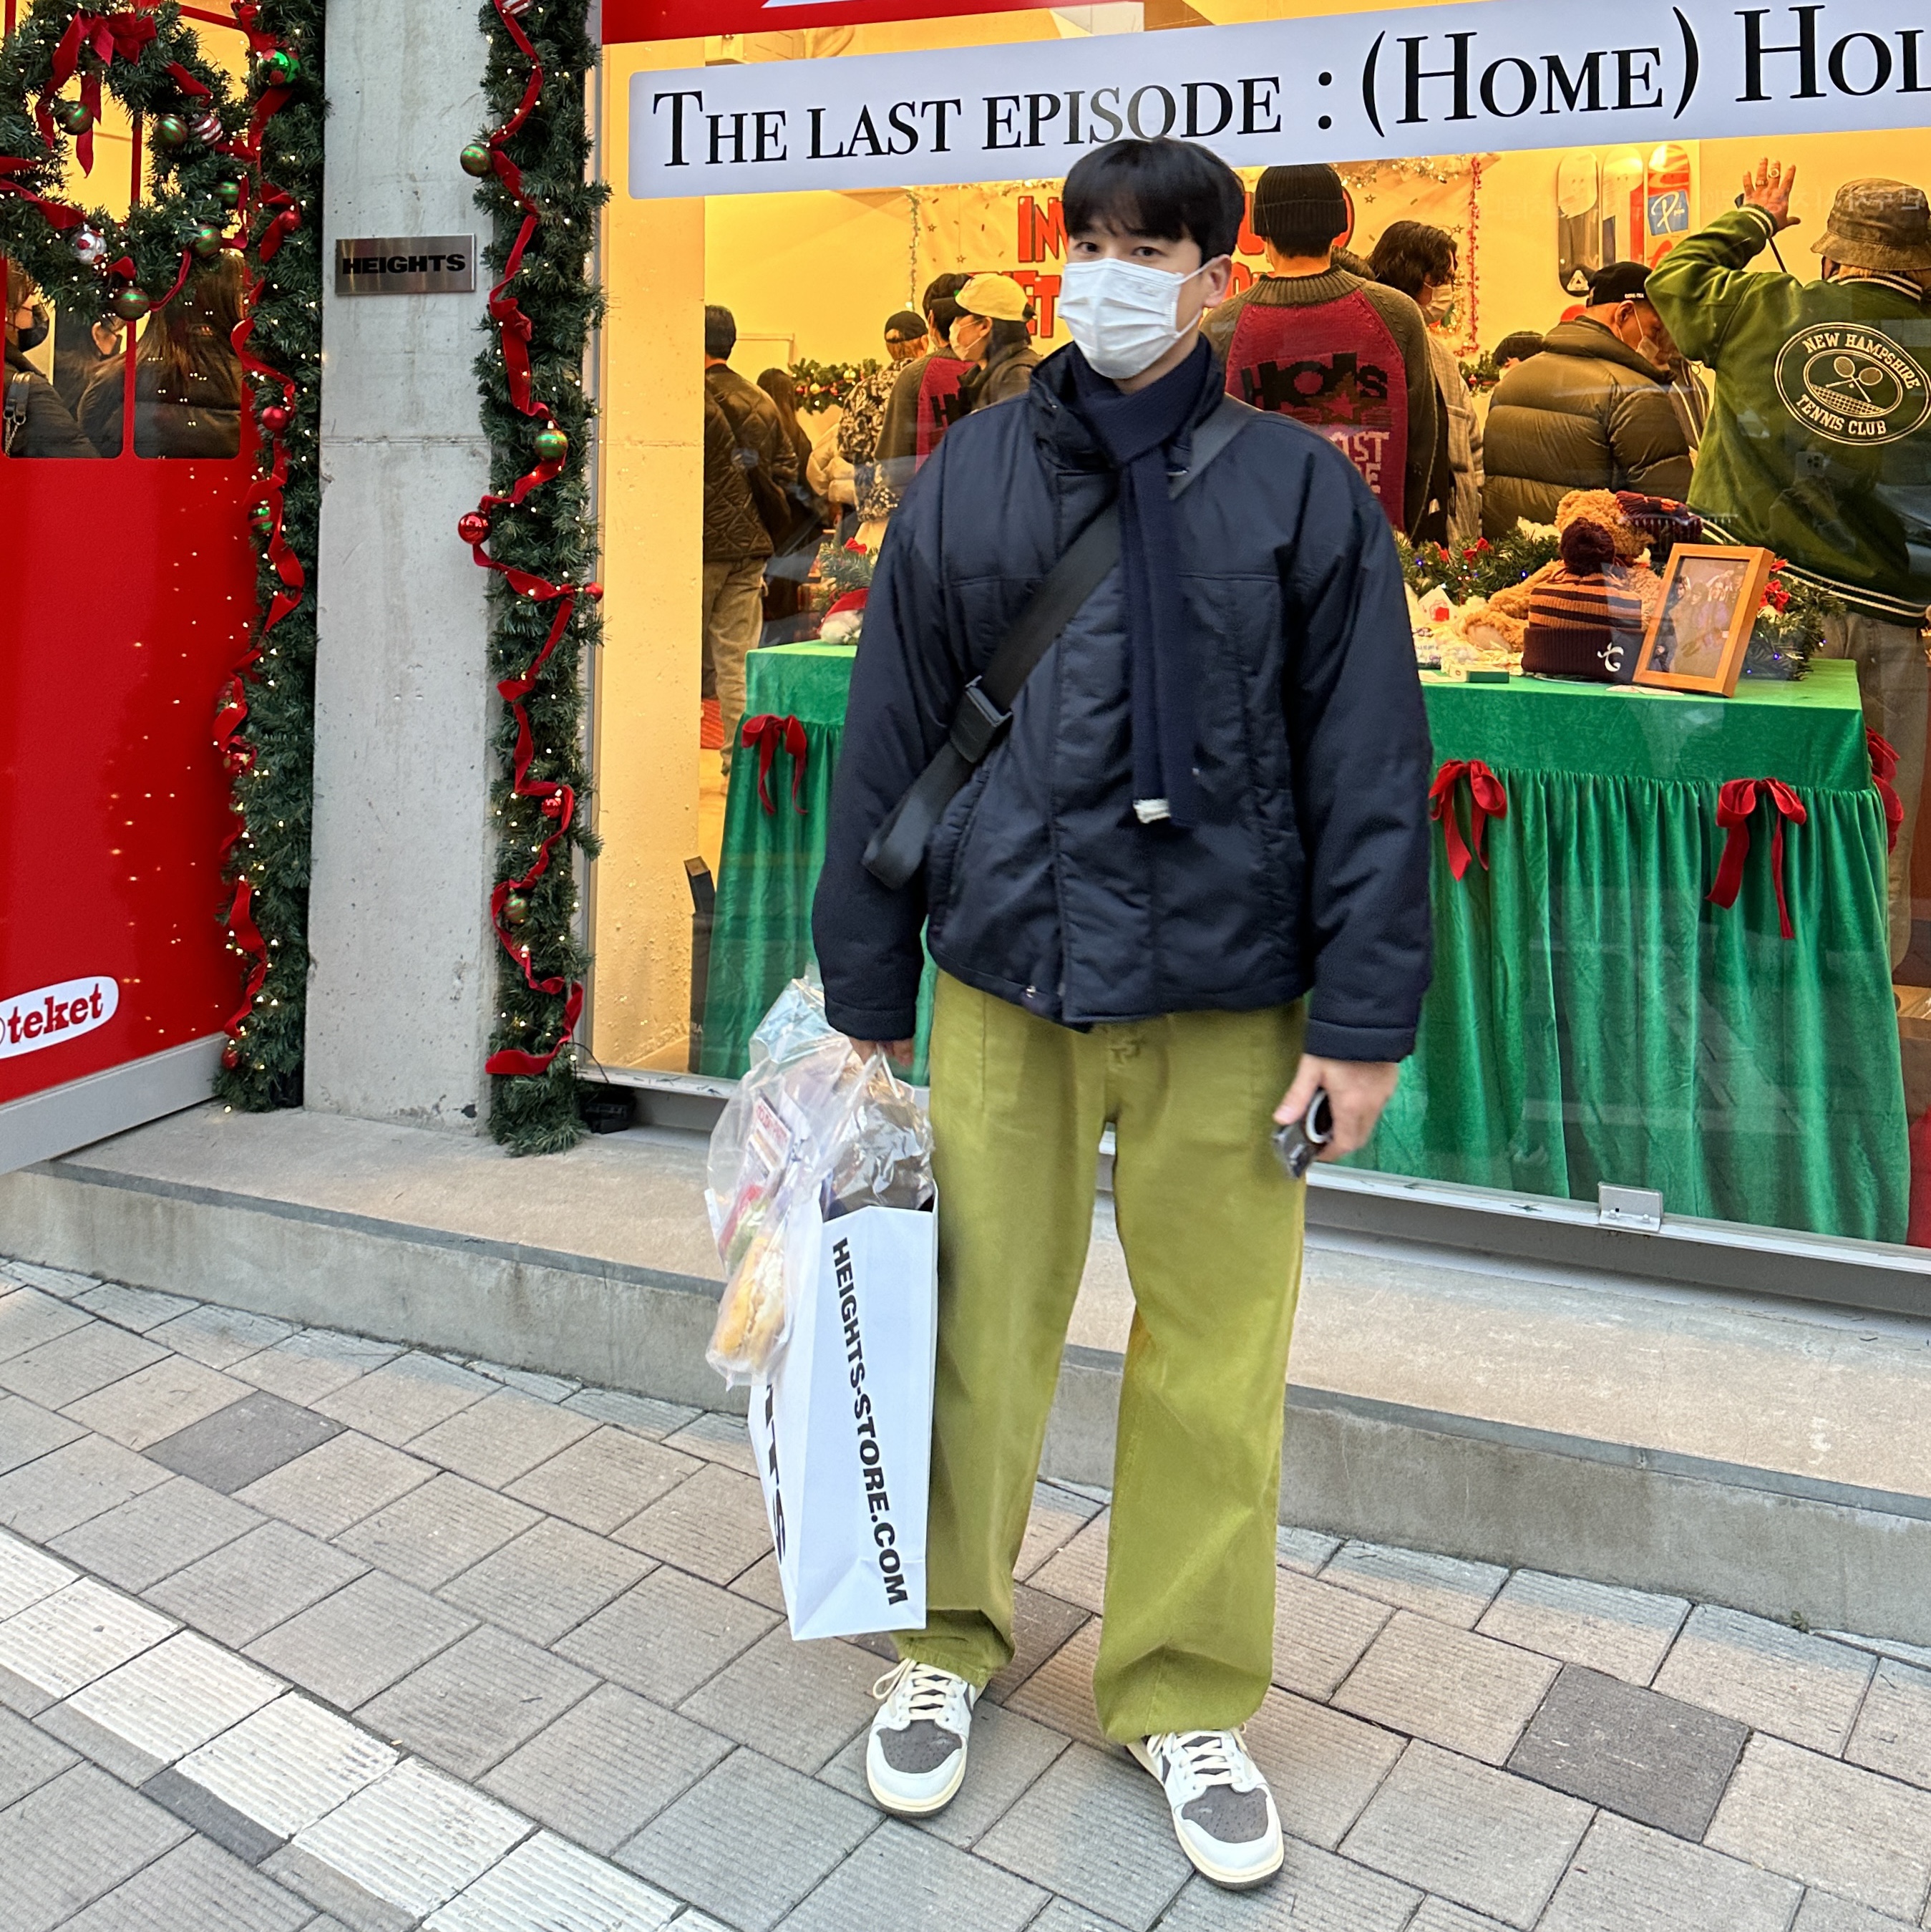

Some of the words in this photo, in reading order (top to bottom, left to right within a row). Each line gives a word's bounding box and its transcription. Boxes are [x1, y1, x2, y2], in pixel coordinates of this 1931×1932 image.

[653, 91, 787, 166] THE
[807, 99, 962, 160] LAST
[982, 77, 1281, 150] EPISODE
[342, 253, 466, 275] HEIGHTS
[1802, 332, 1840, 354] NEW
[1845, 334, 1921, 389] HAMPSHIRE
[1796, 394, 1845, 431] TENNIS
[1848, 420, 1887, 436] CLUB
[832, 1237, 908, 1606] HEIGHTS-STORE.COM
